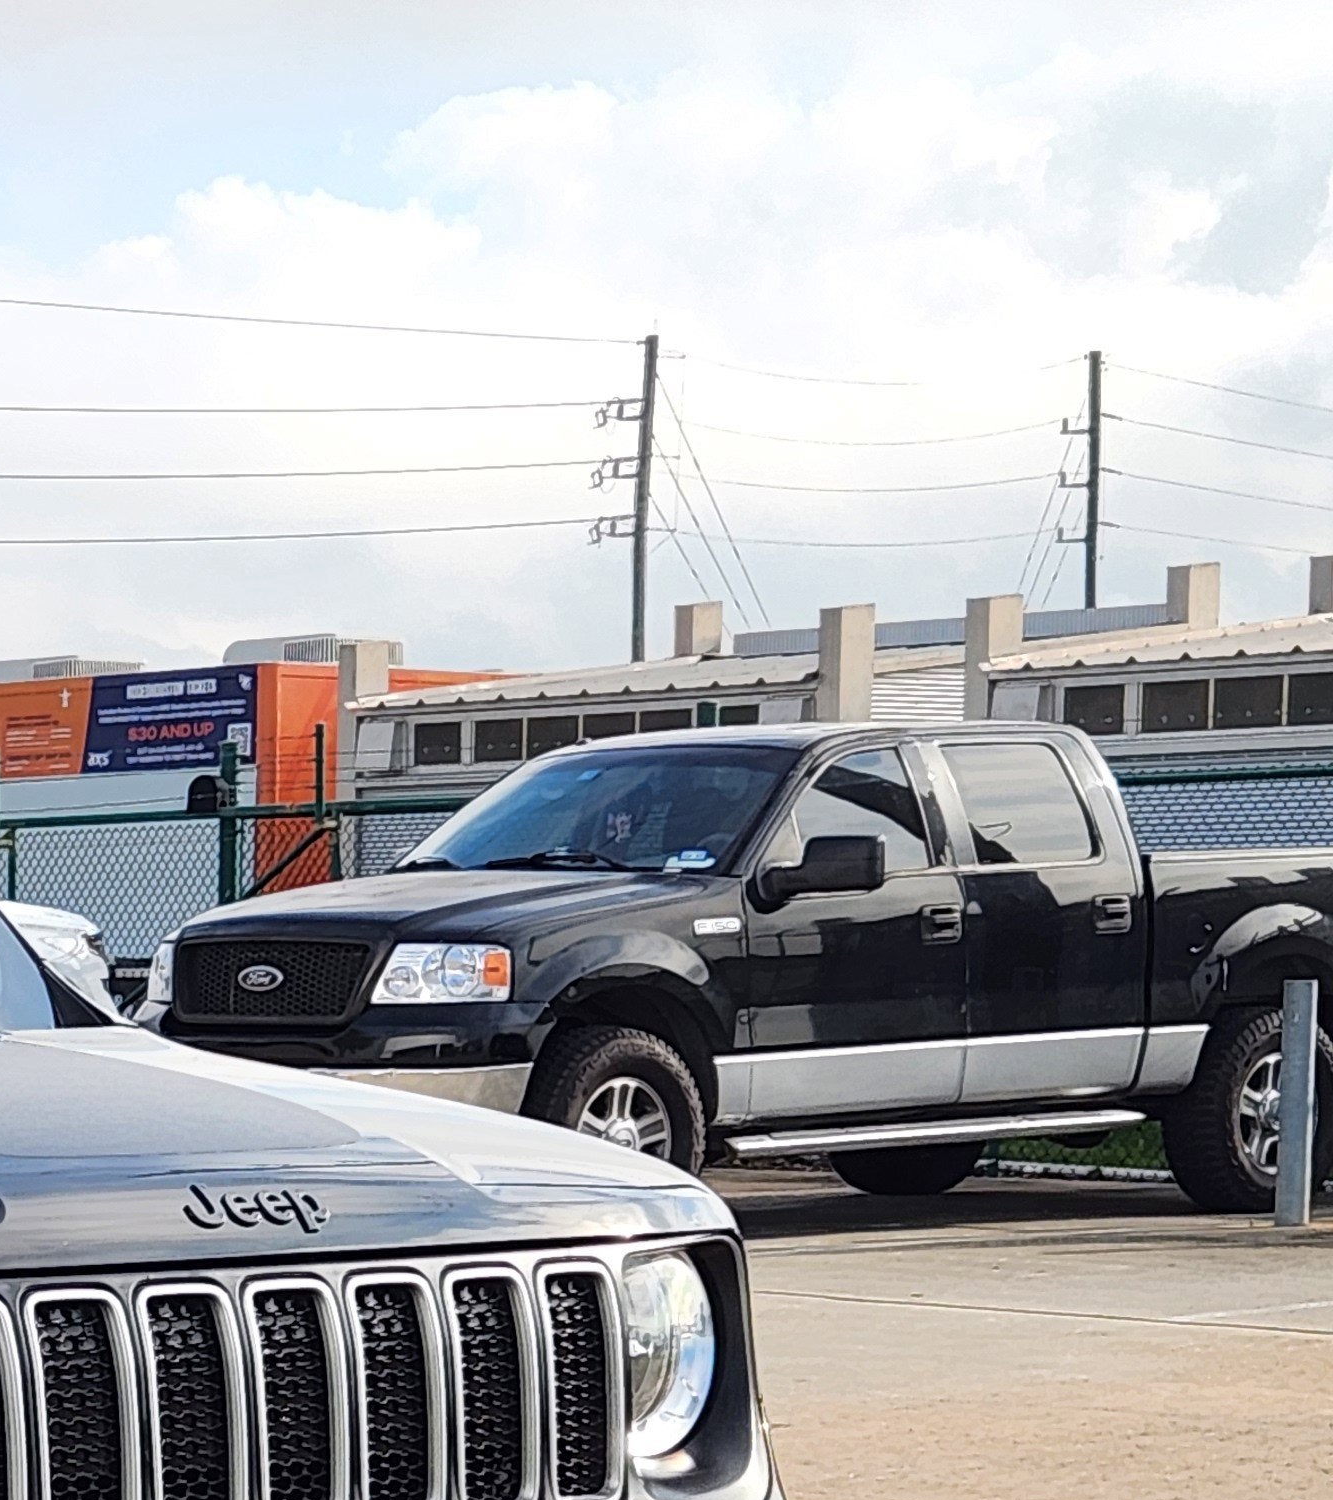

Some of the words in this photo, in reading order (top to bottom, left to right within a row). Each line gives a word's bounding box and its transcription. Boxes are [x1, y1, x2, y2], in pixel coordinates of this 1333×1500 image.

[127, 725, 157, 742] $30
[159, 724, 191, 740] AND
[193, 721, 215, 737] UP
[182, 1184, 331, 1234] Jeep
